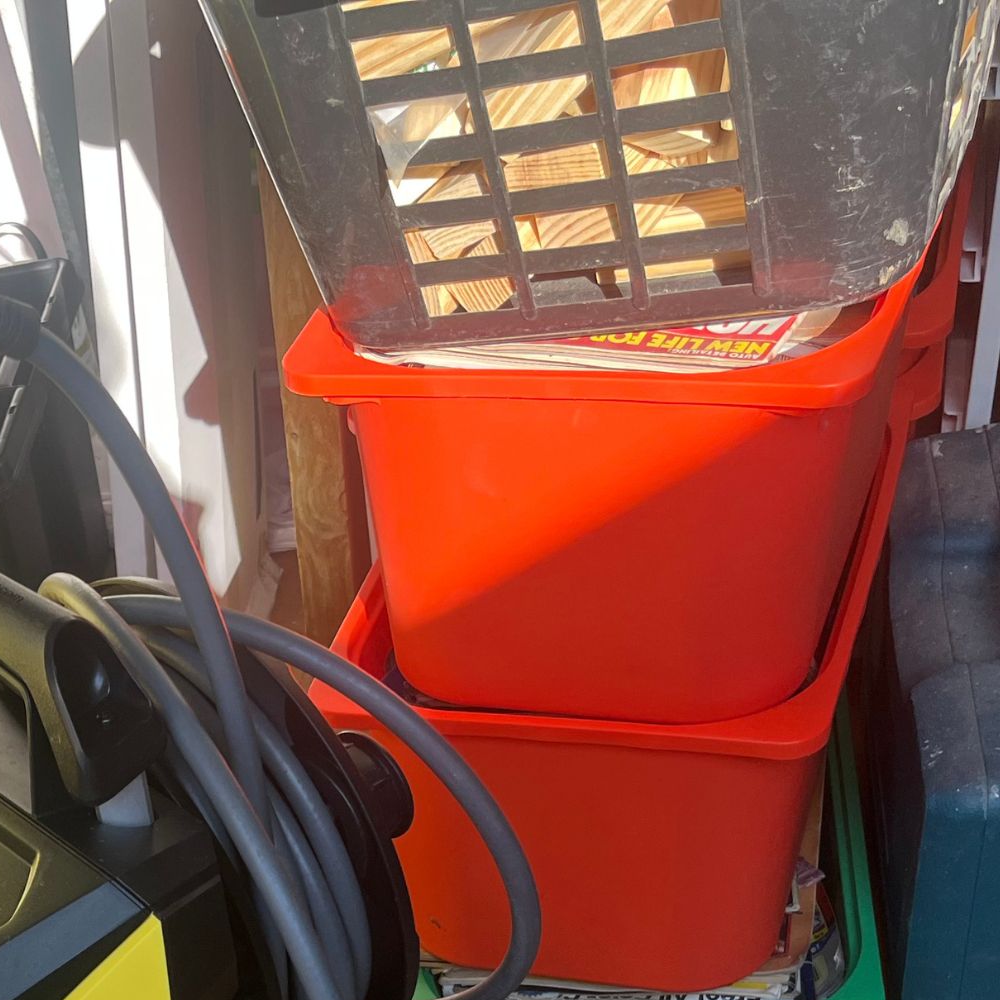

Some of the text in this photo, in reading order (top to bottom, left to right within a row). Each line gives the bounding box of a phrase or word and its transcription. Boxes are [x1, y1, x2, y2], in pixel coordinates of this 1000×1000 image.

[647, 332, 705, 351] LIFE
[706, 339, 772, 356] NEW
[729, 351, 762, 361] AUTO
